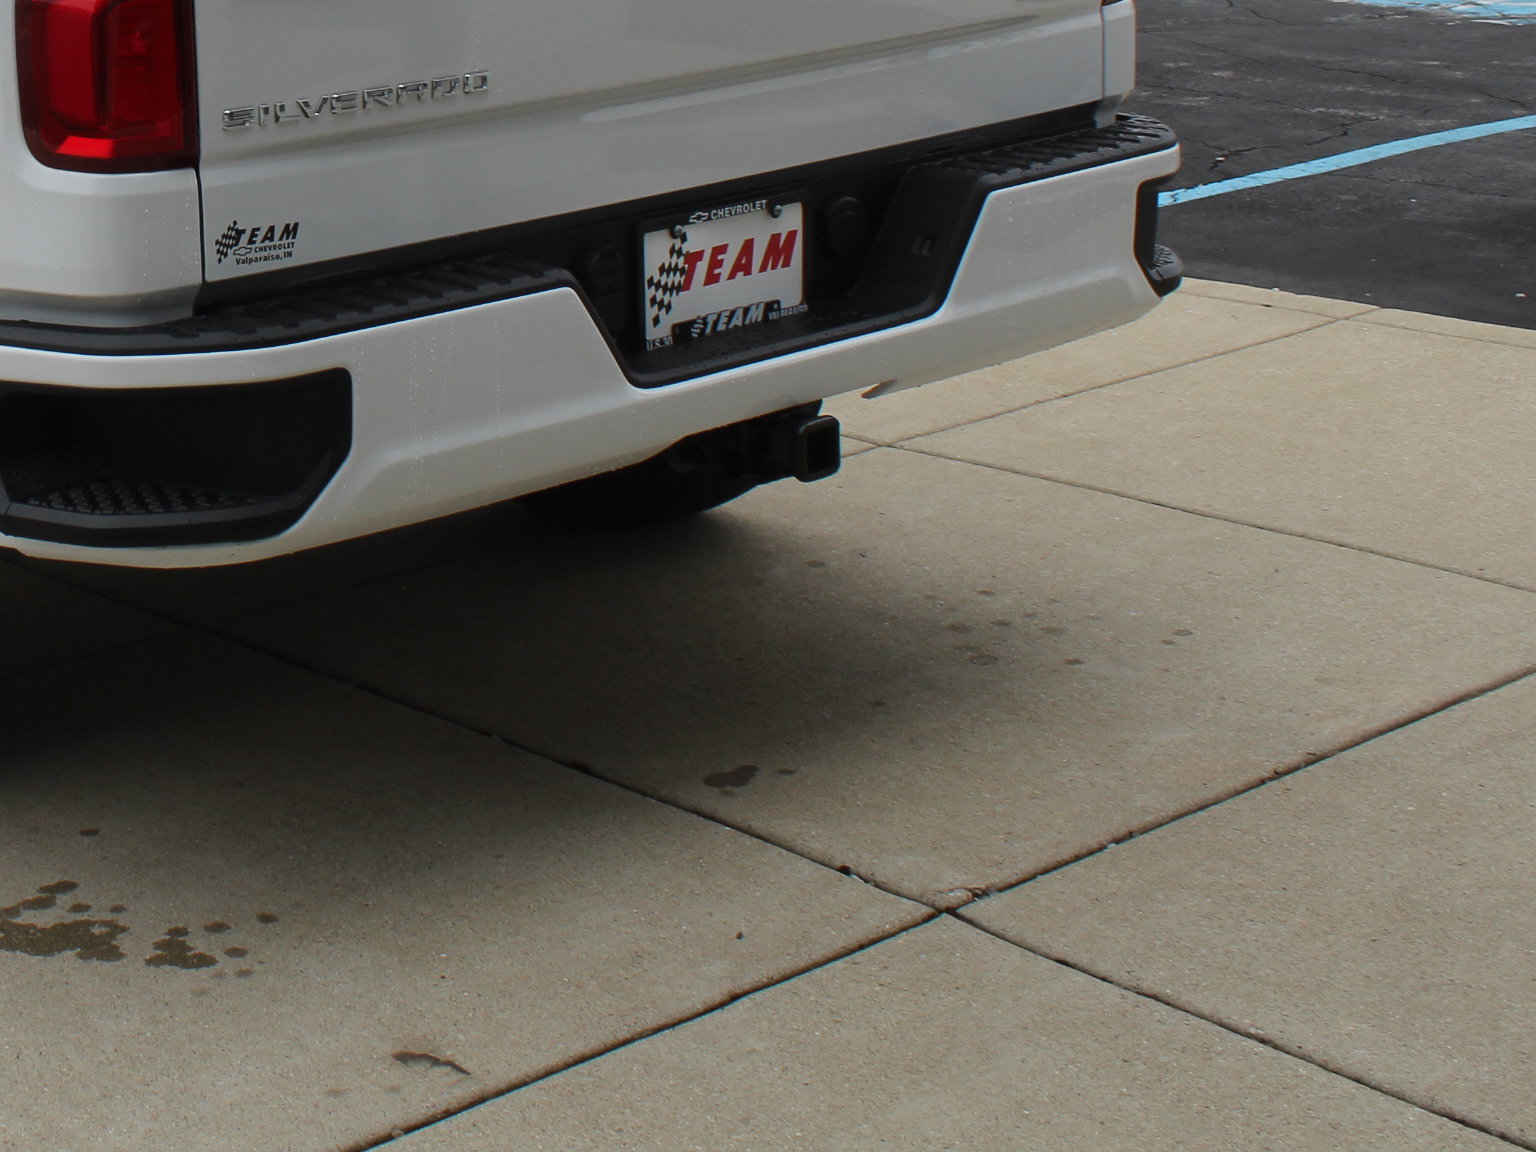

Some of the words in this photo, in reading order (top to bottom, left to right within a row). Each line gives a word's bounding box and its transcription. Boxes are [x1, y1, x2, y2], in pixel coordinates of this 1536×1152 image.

[222, 70, 490, 131] SILVERADO
[710, 199, 768, 221] CHEVROLET
[235, 221, 300, 247] TEAM
[253, 241, 296, 254] CHEVROLET
[284, 250, 294, 259] IN
[679, 229, 799, 293] TEAM
[704, 301, 765, 335] TEAM
